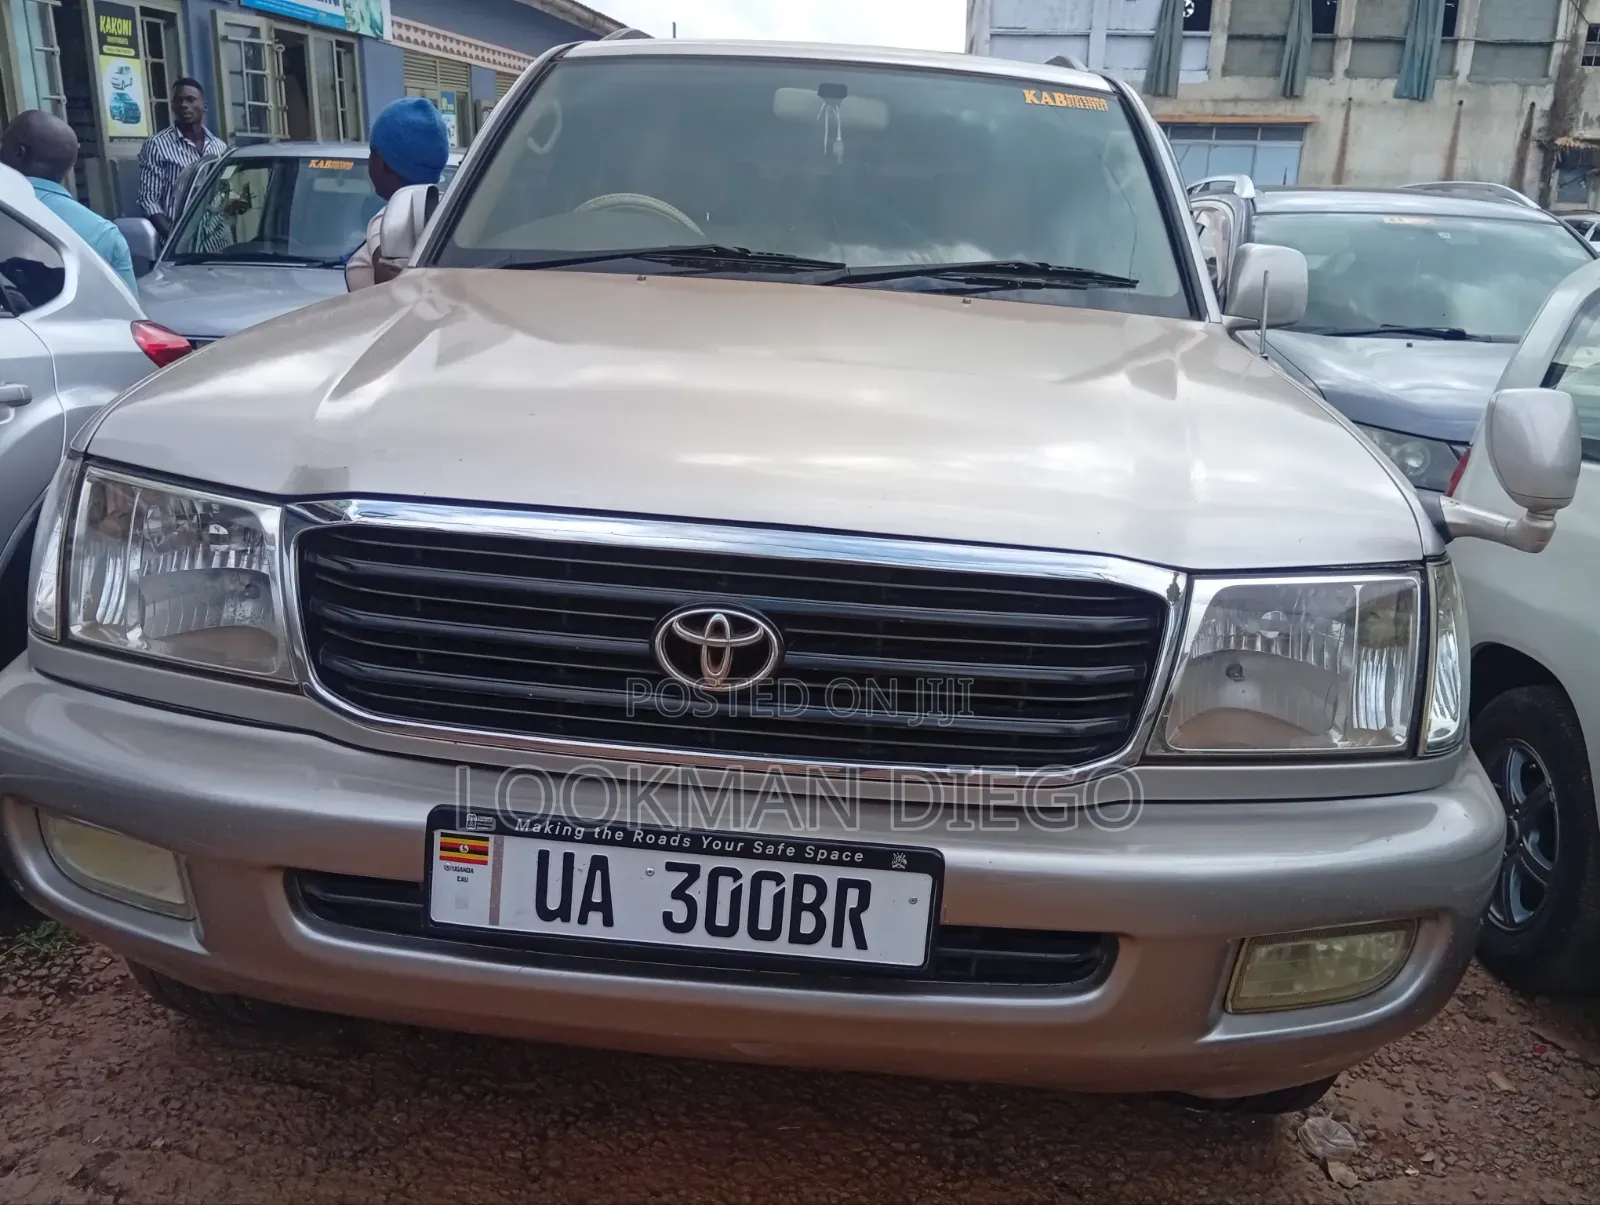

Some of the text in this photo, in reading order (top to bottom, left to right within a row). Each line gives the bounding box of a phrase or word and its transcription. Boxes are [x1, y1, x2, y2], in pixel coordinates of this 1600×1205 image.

[99, 15, 132, 37] KAKONI
[515, 818, 864, 862] Making the Roads Your Safe Space
[452, 865, 475, 874] UGANDA
[456, 875, 469, 883] EAU
[534, 848, 872, 951] UA 300BR
